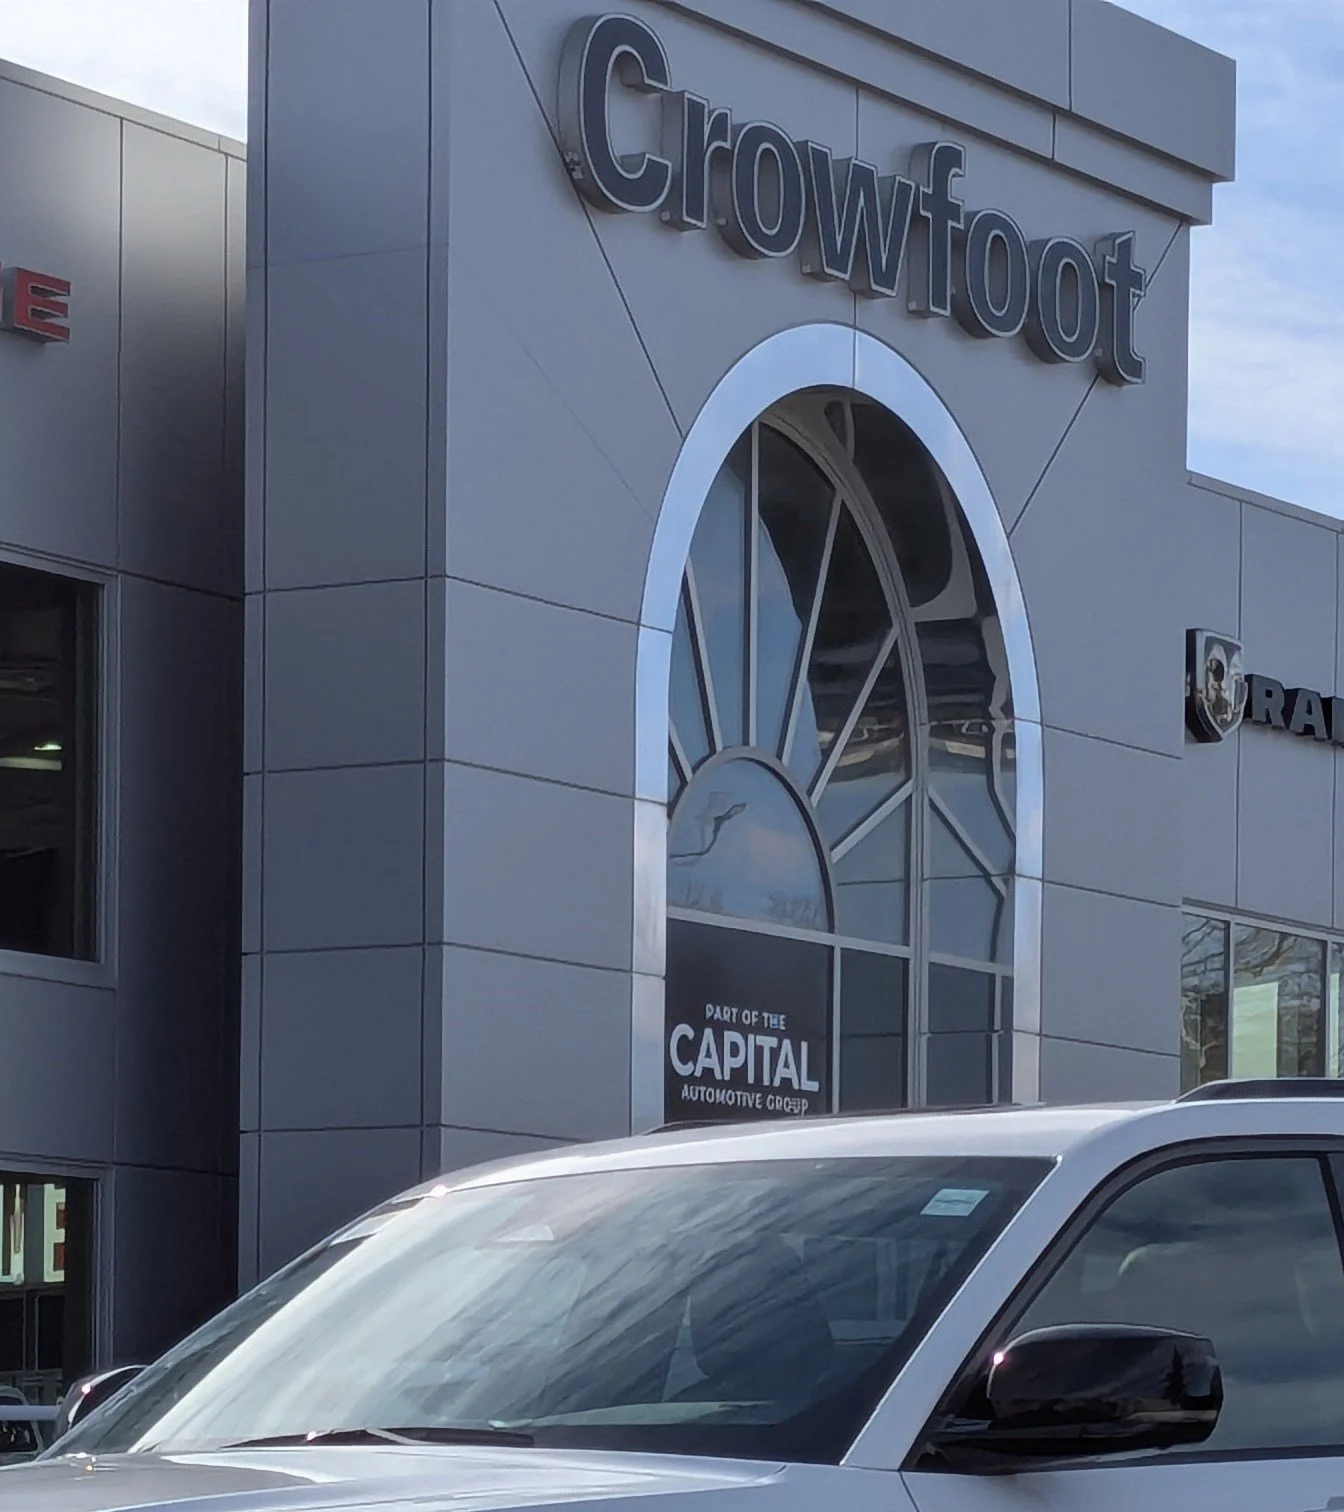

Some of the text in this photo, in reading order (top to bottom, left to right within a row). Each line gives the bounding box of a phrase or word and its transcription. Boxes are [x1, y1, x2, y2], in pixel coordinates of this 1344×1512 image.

[564, 12, 1147, 386] Crowfoot
[706, 1003, 787, 1031] PART OF THE
[669, 1023, 819, 1093] CAPITAL
[681, 1083, 809, 1118] AUTOMOTIVE GROUP
